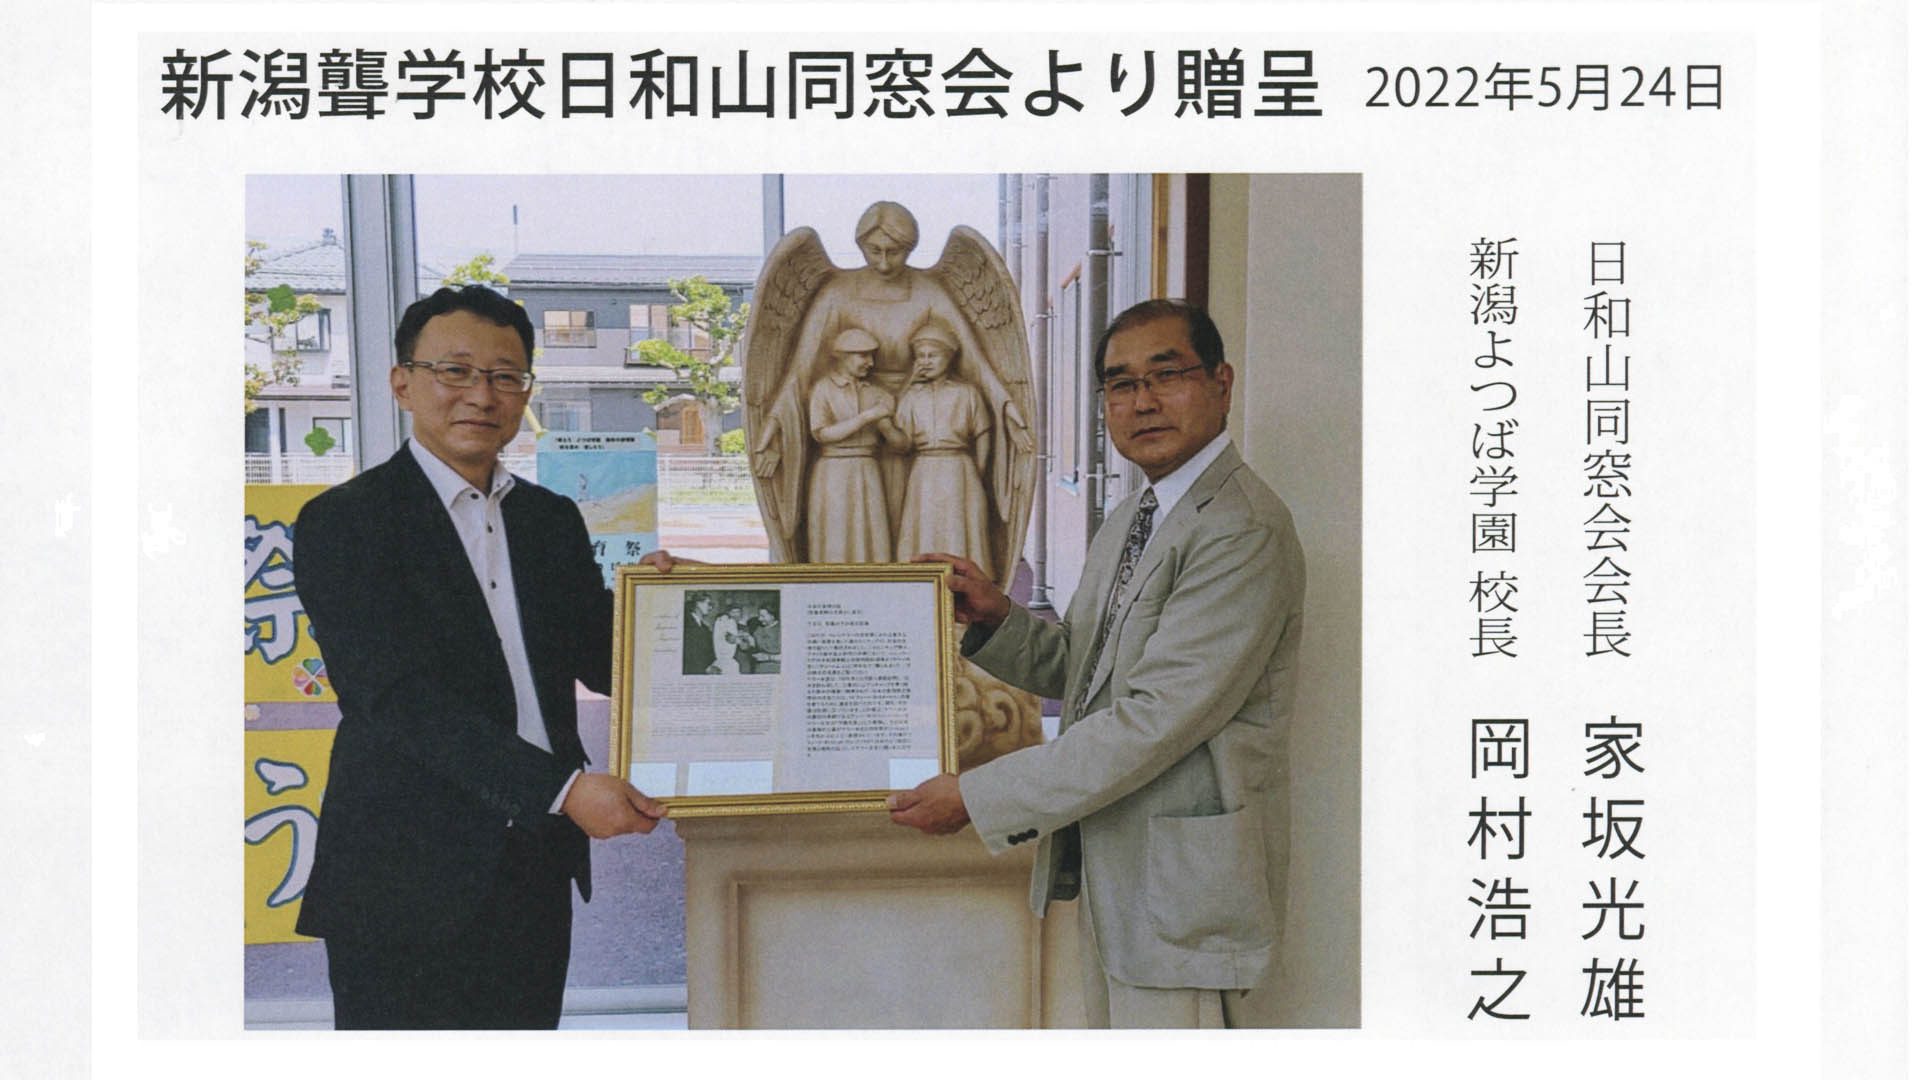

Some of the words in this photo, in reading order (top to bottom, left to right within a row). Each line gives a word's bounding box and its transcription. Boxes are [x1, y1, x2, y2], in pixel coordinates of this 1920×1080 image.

[161, 47, 1323, 120] 新潟聾学校日和山同窓会より贈呈
[1366, 62, 1722, 111] 2022年5月24日
[1470, 237, 1519, 554] 新潟よつば学園
[1583, 241, 1632, 658] 日和山同窓会会長
[1470, 570, 1518, 658] 校長
[1467, 718, 1532, 1021] 岡村浩之
[1580, 715, 1646, 1022] 家坂光雄
